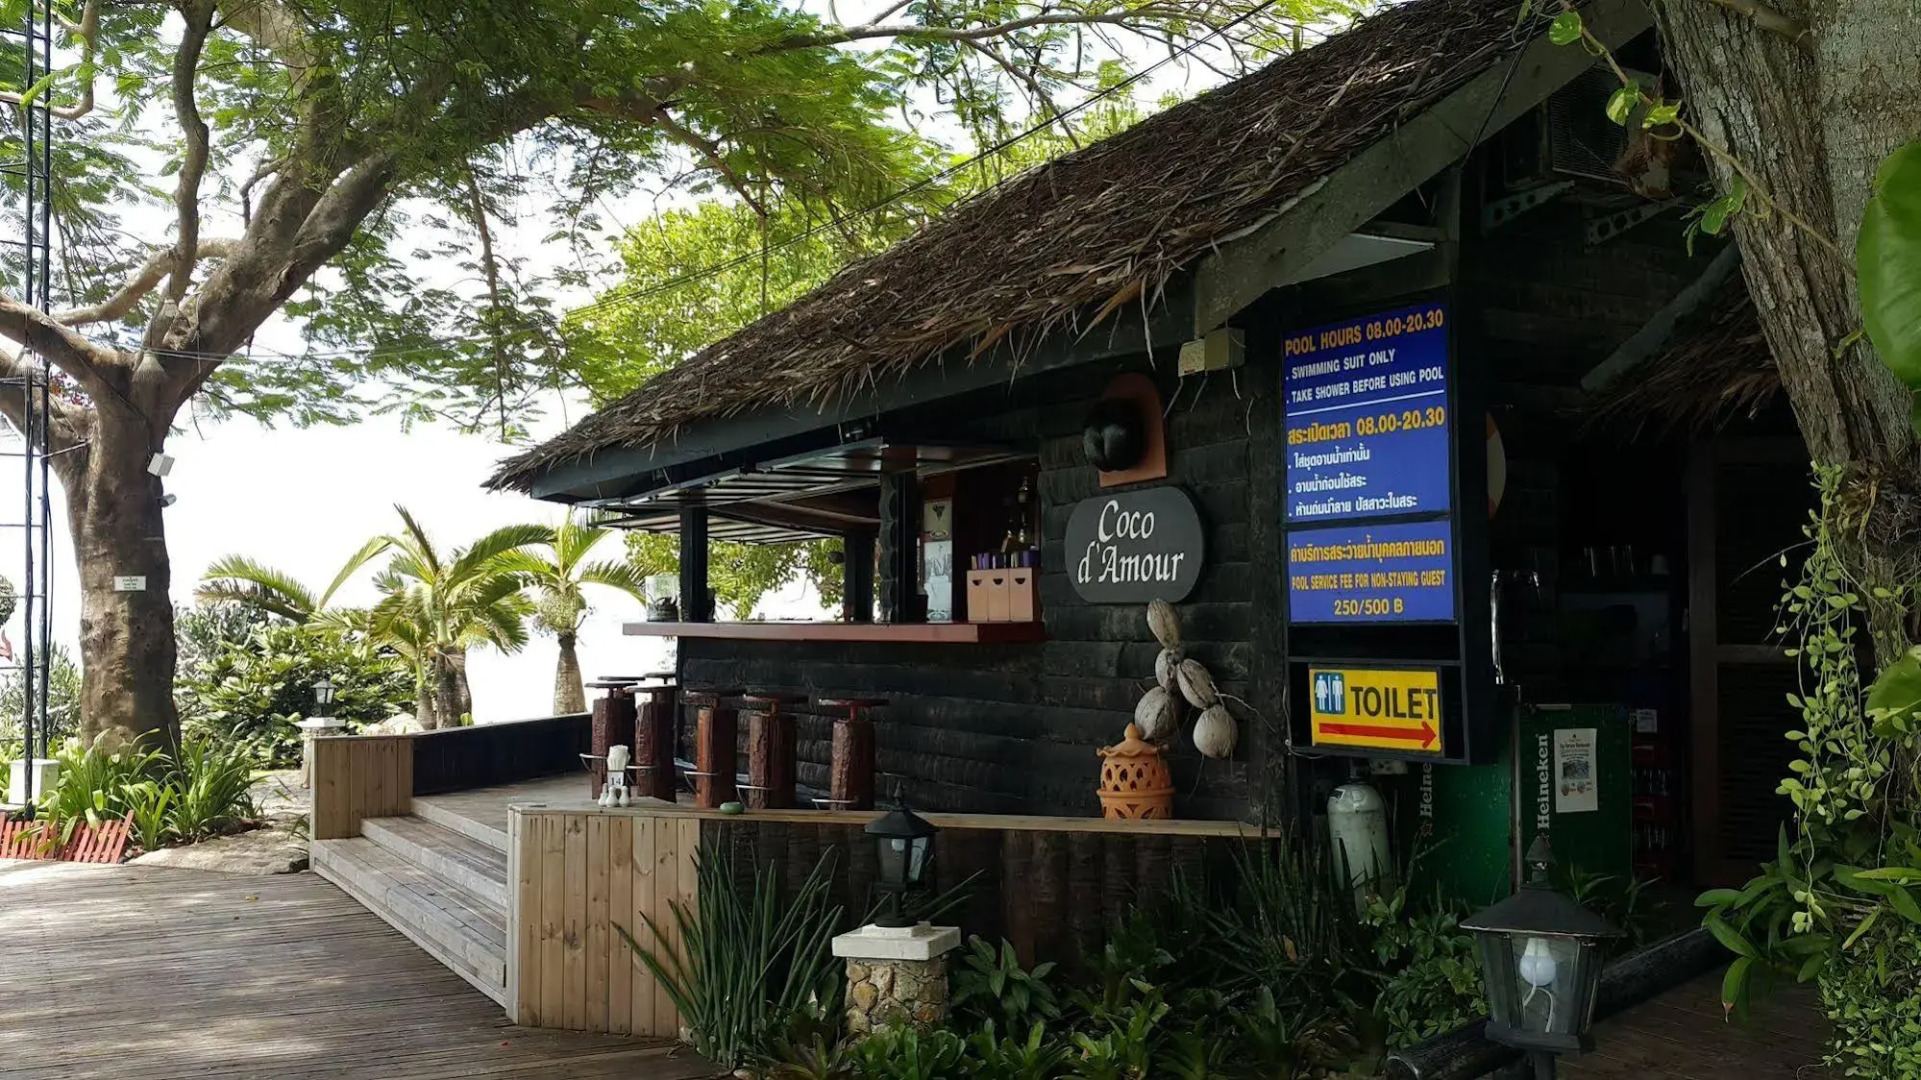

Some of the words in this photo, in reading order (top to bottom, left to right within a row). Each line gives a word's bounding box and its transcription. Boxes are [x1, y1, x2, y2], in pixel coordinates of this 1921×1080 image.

[1285, 336, 1316, 356] POOL
[1320, 325, 1362, 350] HOURS
[1366, 309, 1444, 340] 08.00-20.30
[1292, 359, 1340, 379] SWIMMING
[1343, 354, 1365, 370] SUIT
[1369, 348, 1395, 365] ONLY
[1291, 387, 1313, 403] TAKE
[1315, 382, 1350, 399] SHOWER
[1353, 375, 1386, 393] BEFORE
[1389, 371, 1416, 387] USING
[1419, 366, 1444, 382] POOL
[1357, 406, 1445, 436] 08.00-20.30
[1098, 499, 1155, 543] Coco
[1077, 540, 1185, 584] d'Amour
[1291, 576, 1309, 590] POOL
[1311, 574, 1338, 590] SERVICE
[1340, 573, 1353, 589] FEE
[1355, 573, 1369, 588] FOR
[1371, 570, 1419, 588] NON-STAYING
[1420, 570, 1446, 586] GUEST
[1334, 598, 1390, 616] 250/500
[1350, 686, 1437, 720] TOILET
[1419, 762, 1433, 818] Heine
[1536, 734, 1550, 829] Heineken
